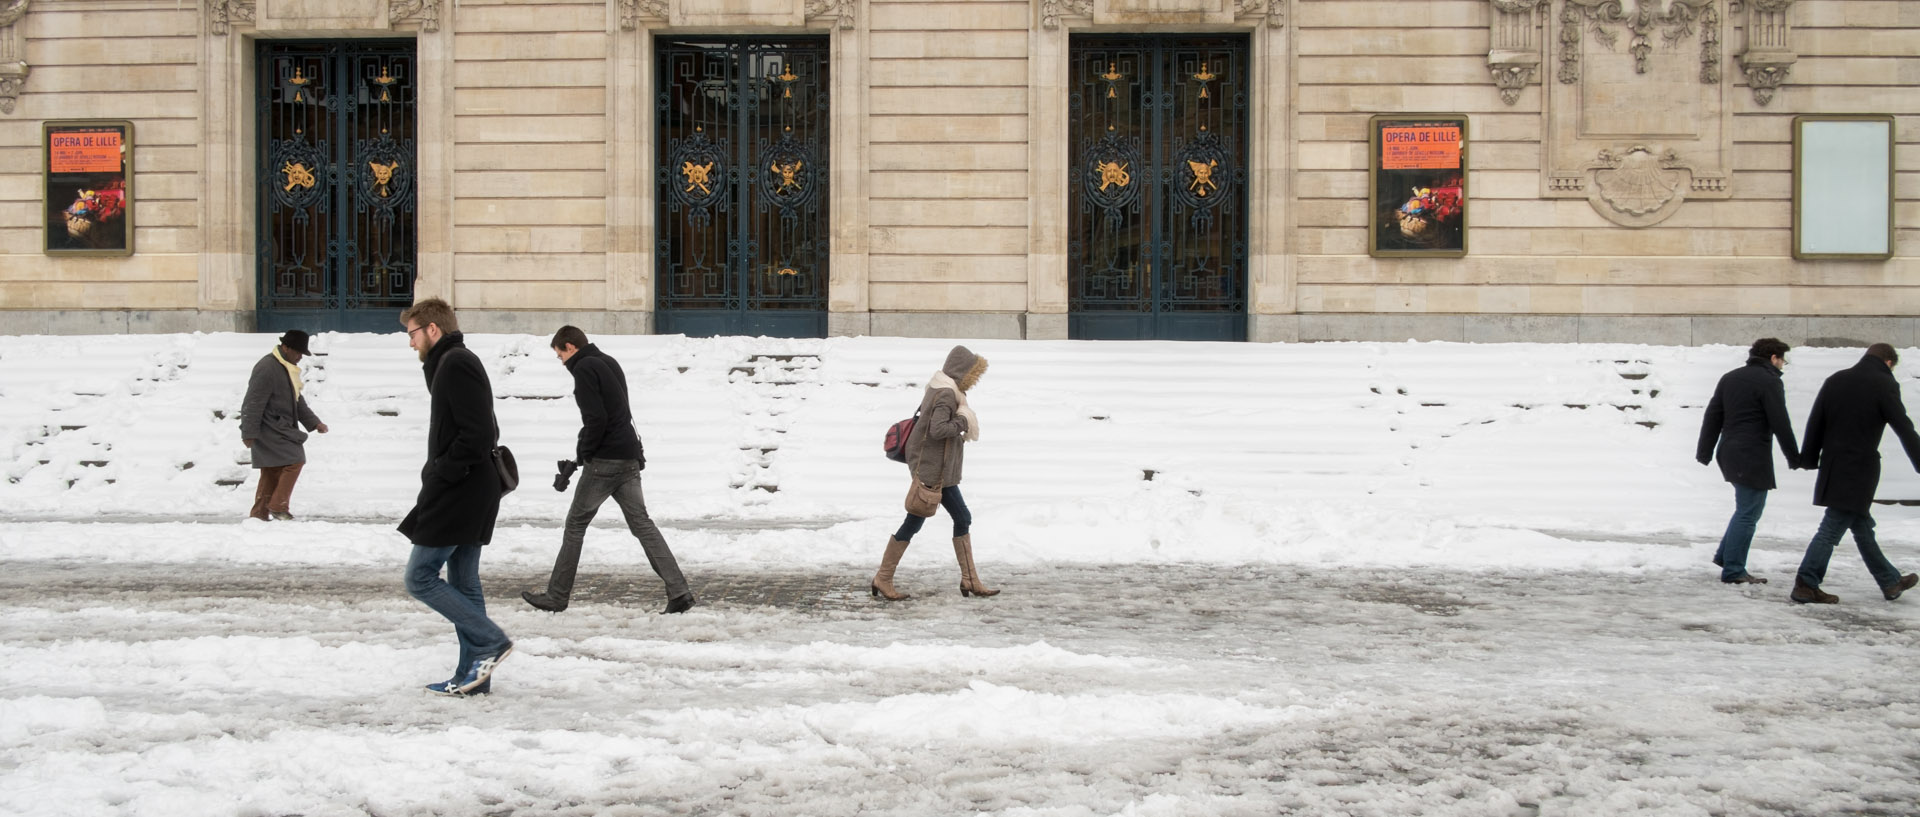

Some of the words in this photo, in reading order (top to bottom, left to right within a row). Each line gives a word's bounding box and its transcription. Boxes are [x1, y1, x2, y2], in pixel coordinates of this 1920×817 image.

[53, 137, 81, 147] OPERA
[83, 137, 94, 146] DE
[96, 136, 117, 146] LILLE
[1386, 132, 1416, 142] OPERA
[1419, 132, 1430, 142] DE
[1433, 132, 1456, 142] LILLE
